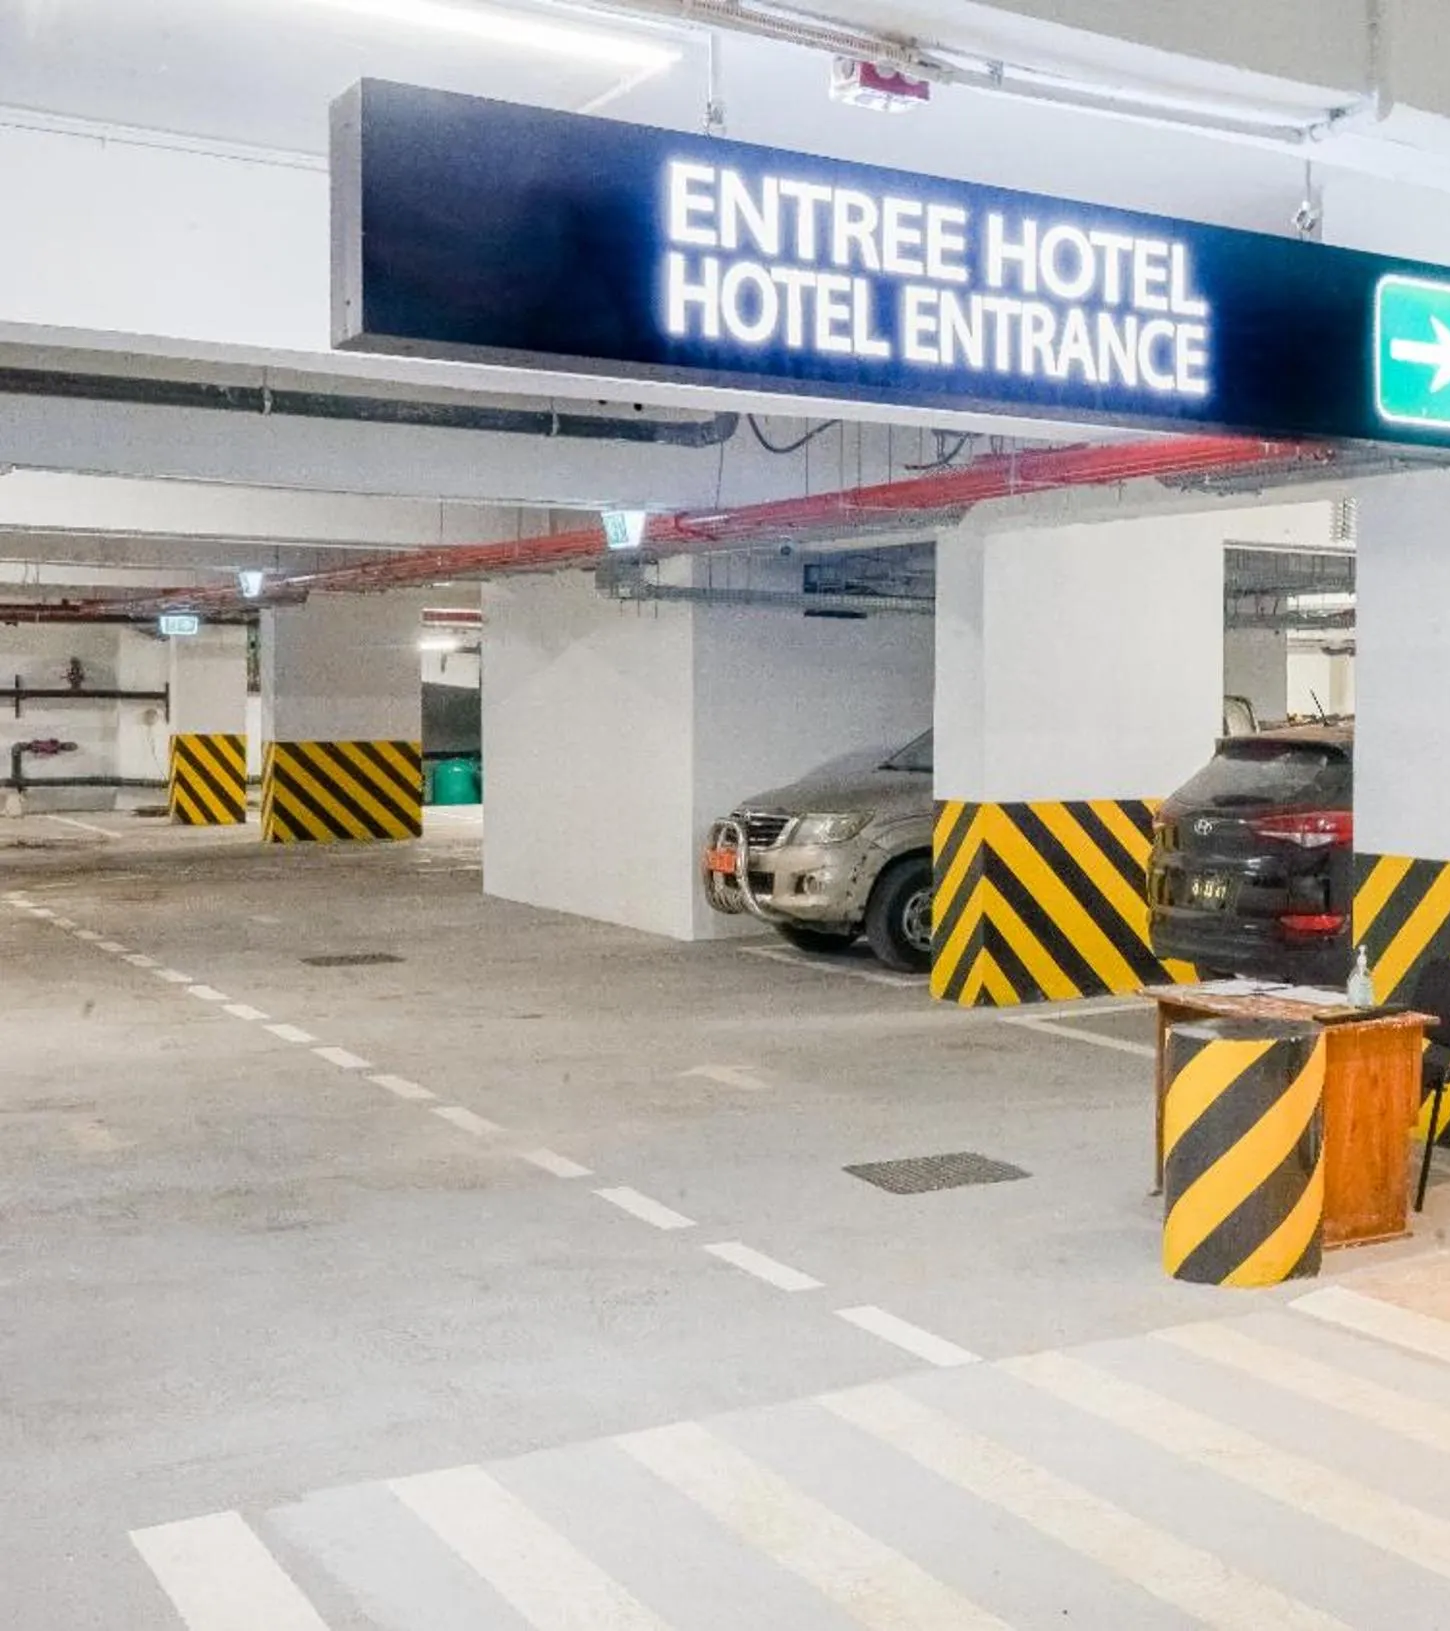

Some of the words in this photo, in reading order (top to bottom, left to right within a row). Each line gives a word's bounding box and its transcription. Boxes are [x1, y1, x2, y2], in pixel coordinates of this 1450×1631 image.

[669, 161, 968, 283] ENTREE
[987, 213, 1209, 317] HOTEL
[668, 253, 889, 357] HOTEL
[905, 286, 1209, 395] ENTRANCE
